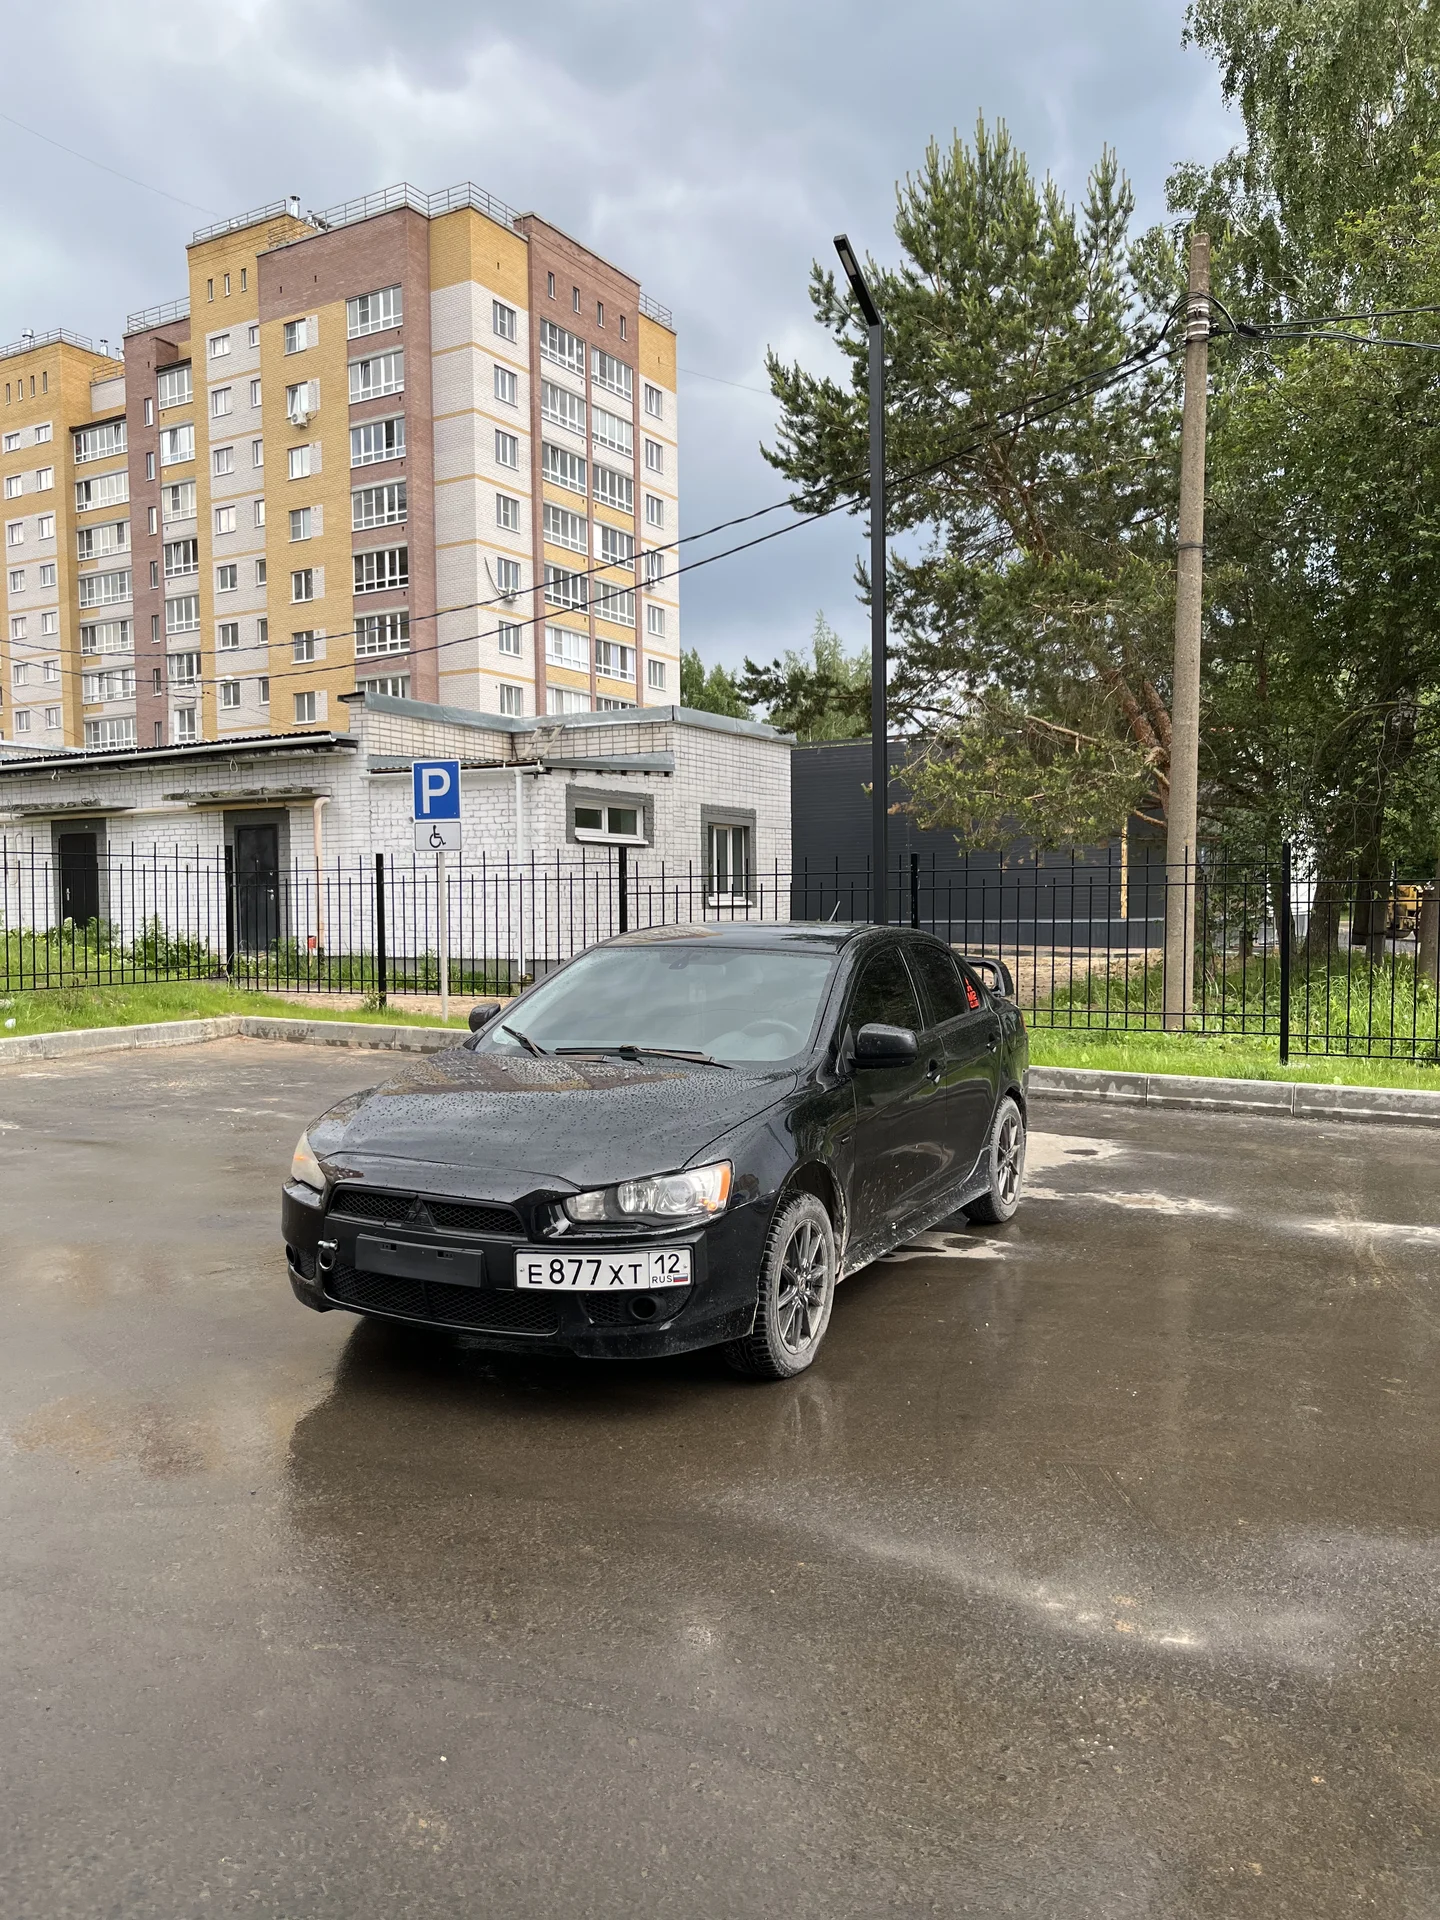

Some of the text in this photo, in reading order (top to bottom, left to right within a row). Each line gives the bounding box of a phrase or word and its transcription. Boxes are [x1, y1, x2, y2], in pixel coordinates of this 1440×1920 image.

[421, 767, 451, 814] P
[654, 1253, 680, 1274] 12
[651, 1275, 673, 1284] RUS
